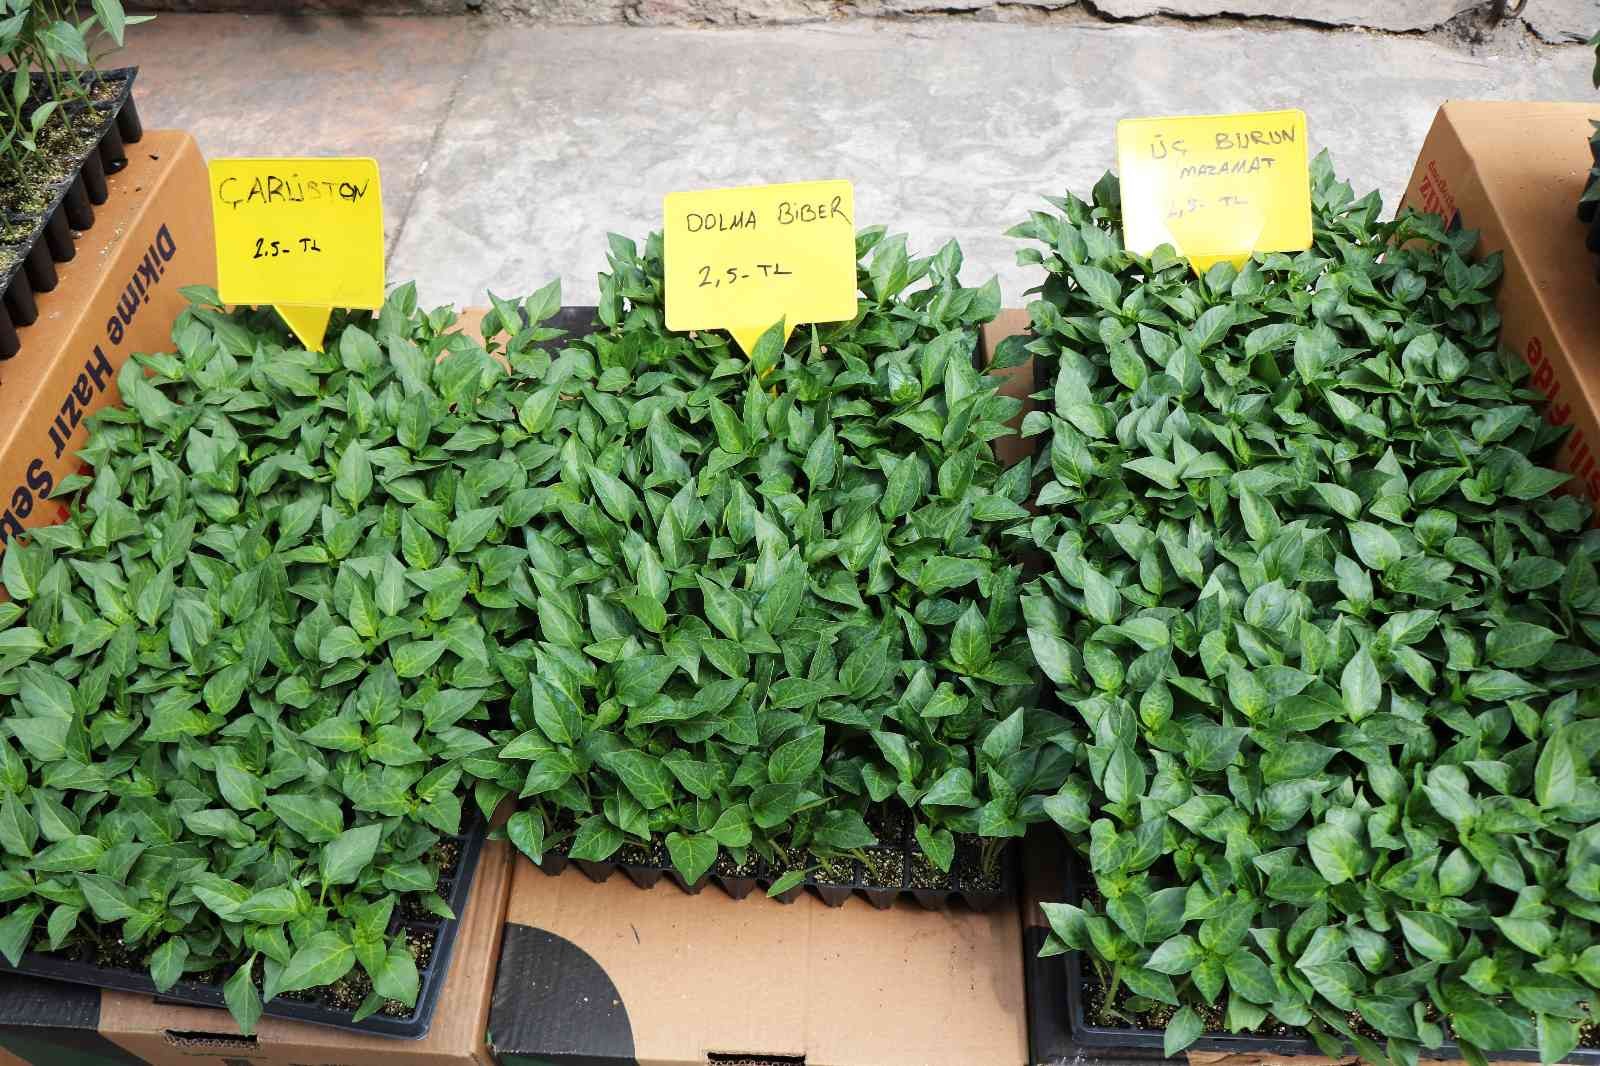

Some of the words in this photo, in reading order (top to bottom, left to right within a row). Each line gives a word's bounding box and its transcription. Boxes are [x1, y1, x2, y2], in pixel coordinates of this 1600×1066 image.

[1215, 124, 1296, 150] BURUN
[686, 210, 757, 232] DOLMA
[107, 223, 177, 345] Dikime
[48, 344, 114, 459] Hazır
[0, 458, 53, 562] Seb
